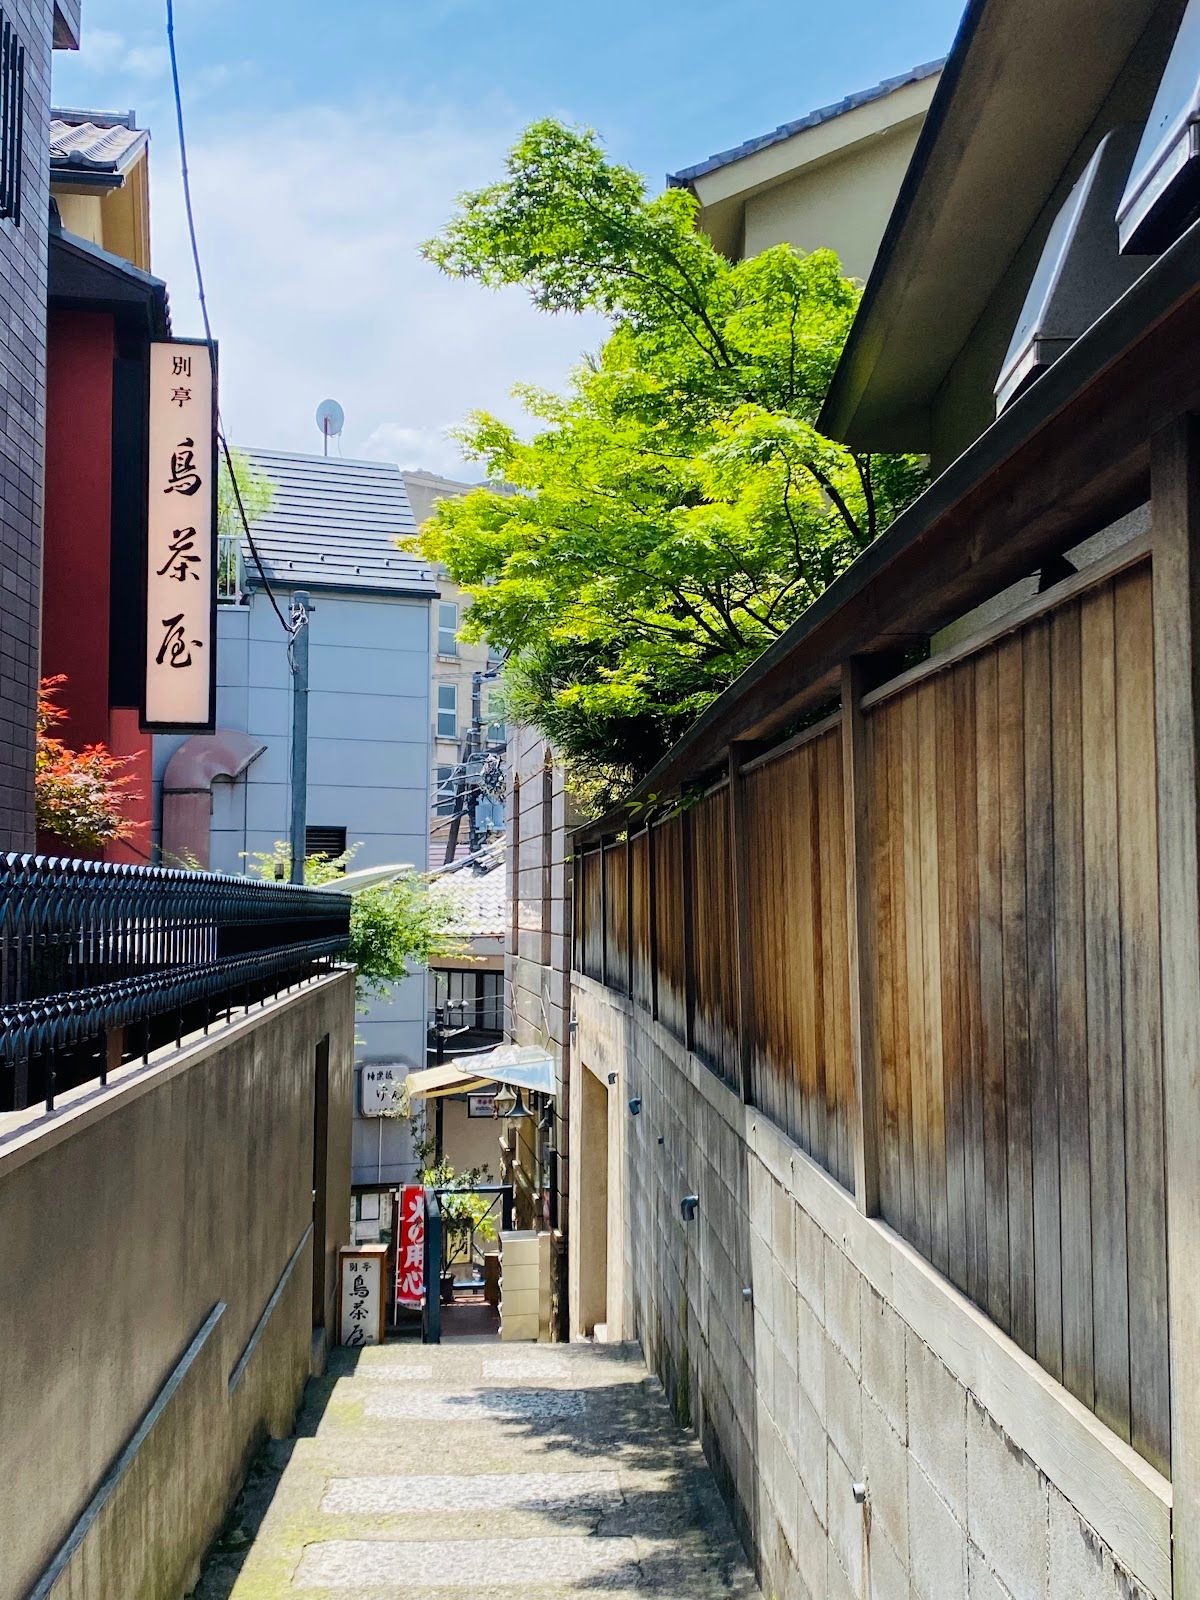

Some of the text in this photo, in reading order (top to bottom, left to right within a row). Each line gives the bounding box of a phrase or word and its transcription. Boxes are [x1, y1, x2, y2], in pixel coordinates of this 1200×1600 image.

[156, 356, 203, 667] 別亭 鳥茶屋
[402, 1195, 424, 1297] 火の用心
[345, 1274, 374, 1346] 鳥茶屋
